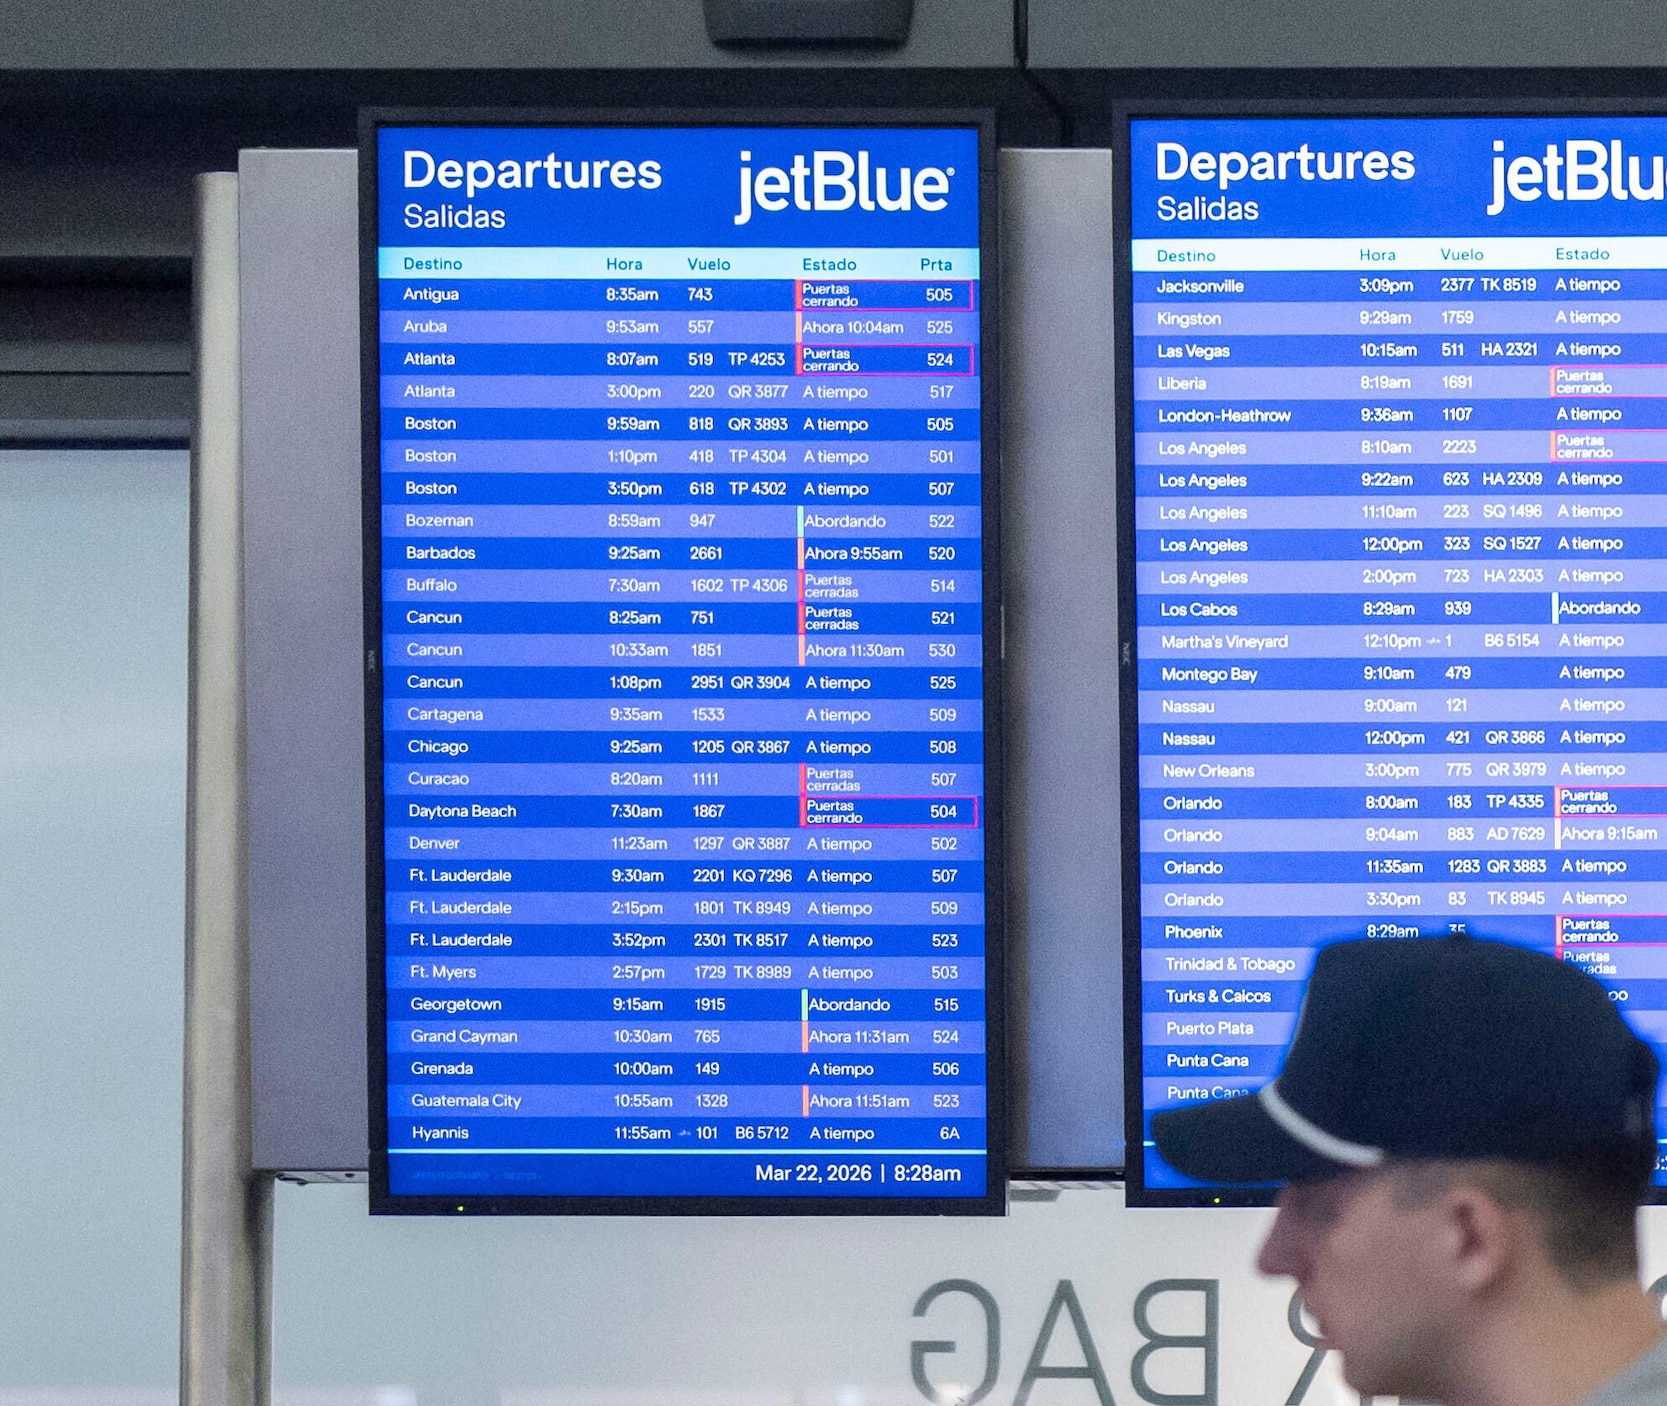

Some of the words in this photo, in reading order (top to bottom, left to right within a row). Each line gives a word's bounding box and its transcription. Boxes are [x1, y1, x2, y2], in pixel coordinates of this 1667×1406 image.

[404, 150, 662, 199] Departures
[1156, 142, 1416, 191] Departures
[404, 203, 506, 229] Salidas
[1157, 195, 1260, 221] Salidas
[403, 256, 463, 271] Destino
[606, 257, 643, 271] Hora
[687, 257, 731, 271] Vuelo
[802, 257, 857, 271] Estado
[920, 257, 953, 272] Prta
[1156, 278, 1245, 294] Jacksonville
[1359, 277, 1414, 295] 3:09pm
[1440, 277, 1475, 292] 2377
[1480, 277, 1501, 292] TK
[1501, 277, 1537, 292] 8519
[1555, 277, 1567, 291] A
[1568, 277, 1621, 294] tiempo
[404, 384, 457, 398] Atlanta
[607, 384, 662, 401] 3:00pm
[688, 384, 715, 399] 220
[727, 384, 752, 399] QR
[754, 384, 789, 399] 3877
[802, 384, 815, 398] A
[816, 384, 869, 402] tiempo
[929, 384, 954, 399] 517
[755, 1164, 793, 1182] Mar
[795, 1164, 823, 1184] 22,
[826, 1164, 872, 1182] 2026
[894, 1164, 962, 1182] 8:28am
